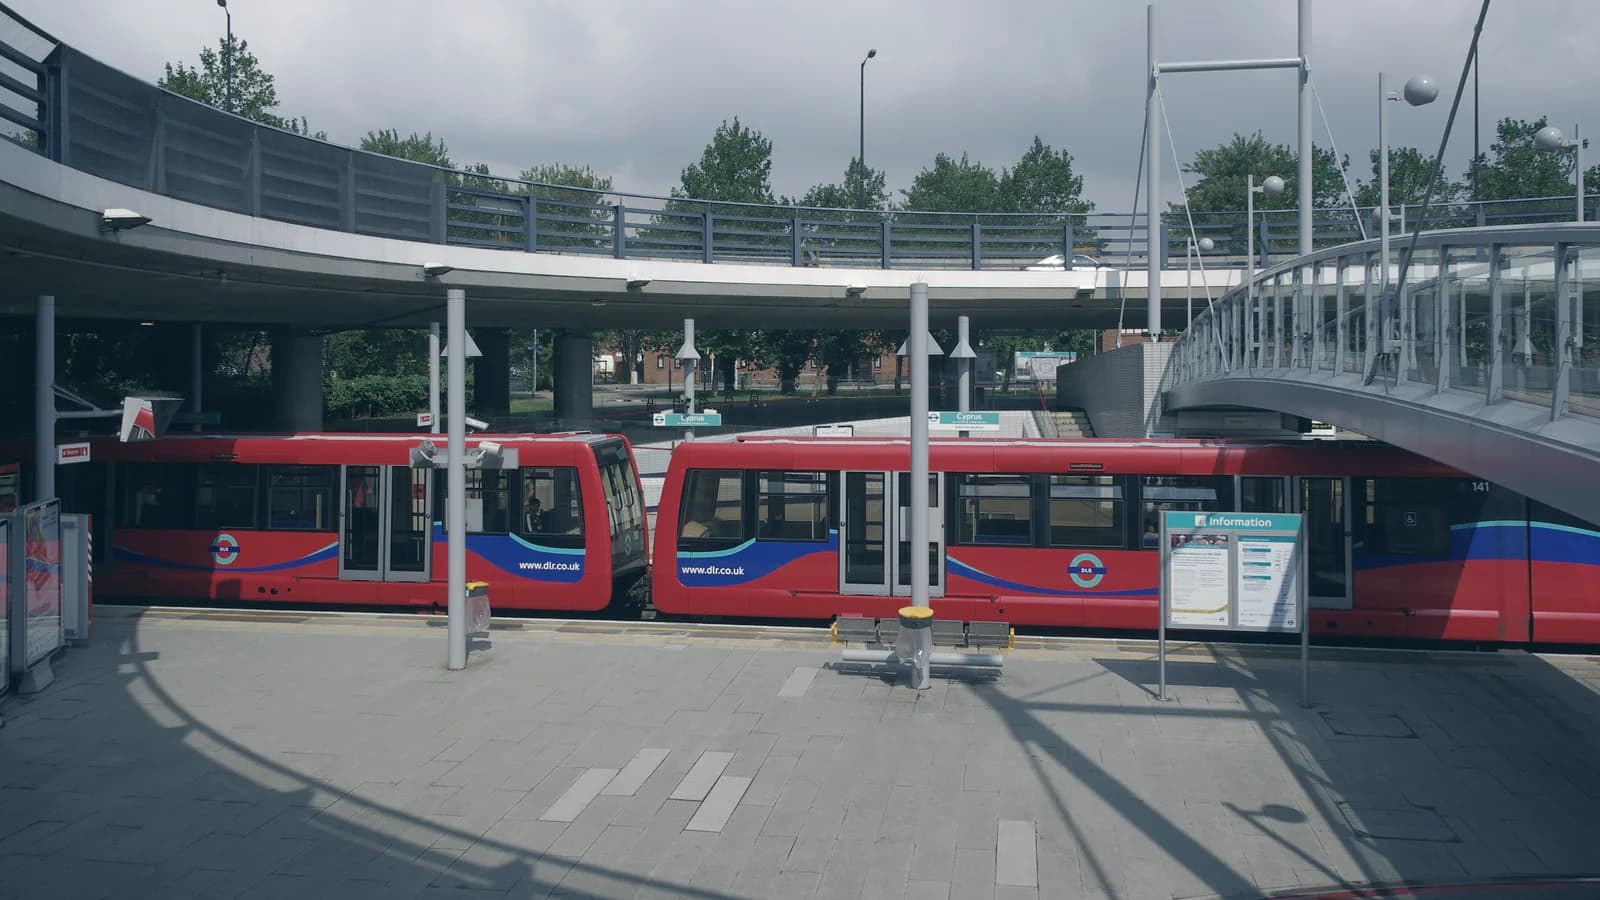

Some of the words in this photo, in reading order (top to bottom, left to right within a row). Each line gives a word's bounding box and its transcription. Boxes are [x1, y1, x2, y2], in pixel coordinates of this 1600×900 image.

[680, 414, 705, 423] Cyprus
[956, 412, 983, 421] Cyprus
[1471, 481, 1489, 492] 141
[1209, 516, 1272, 527] Information
[519, 561, 580, 571] www.dlr.co.uk
[681, 565, 745, 576] www.dlr.co.uk
